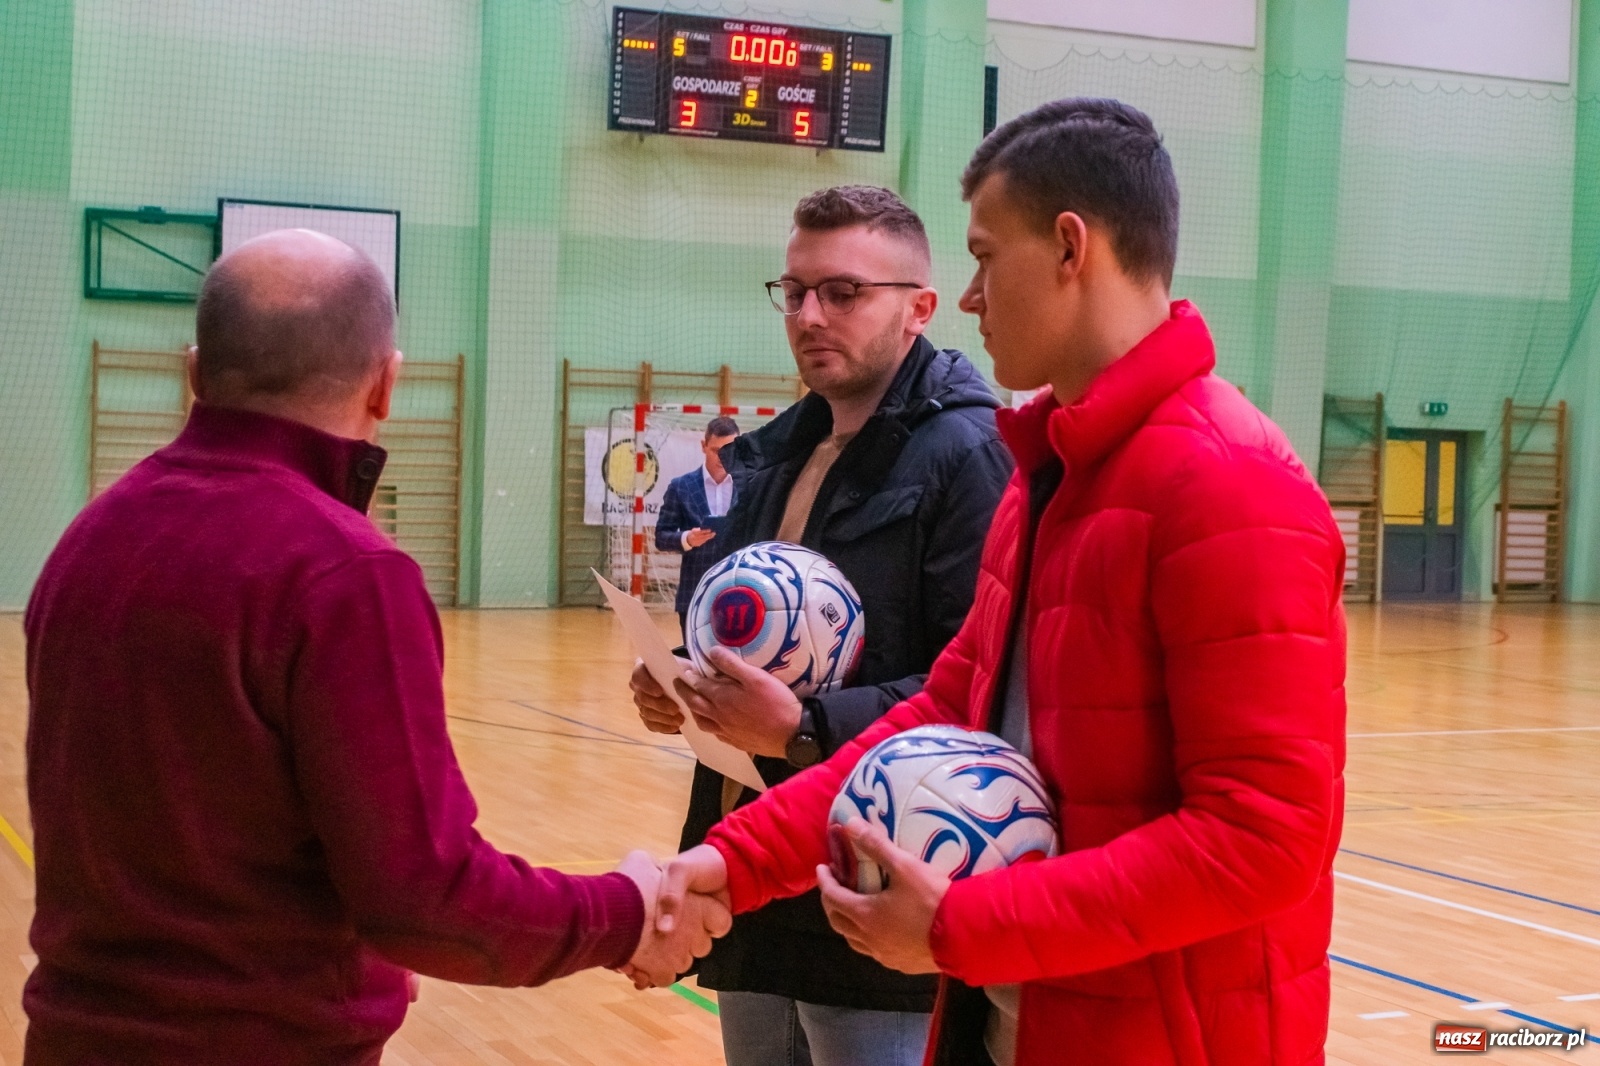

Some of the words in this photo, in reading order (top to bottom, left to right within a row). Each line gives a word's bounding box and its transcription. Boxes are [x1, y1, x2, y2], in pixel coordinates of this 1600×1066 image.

[673, 38, 684, 57] 5
[822, 52, 833, 71] 3
[672, 76, 742, 96] GOSPODARZE
[778, 84, 816, 104] GOŚCIE
[745, 90, 758, 108] 2
[680, 100, 696, 126] 3
[732, 112, 751, 126] 3D
[794, 112, 810, 136] 5
